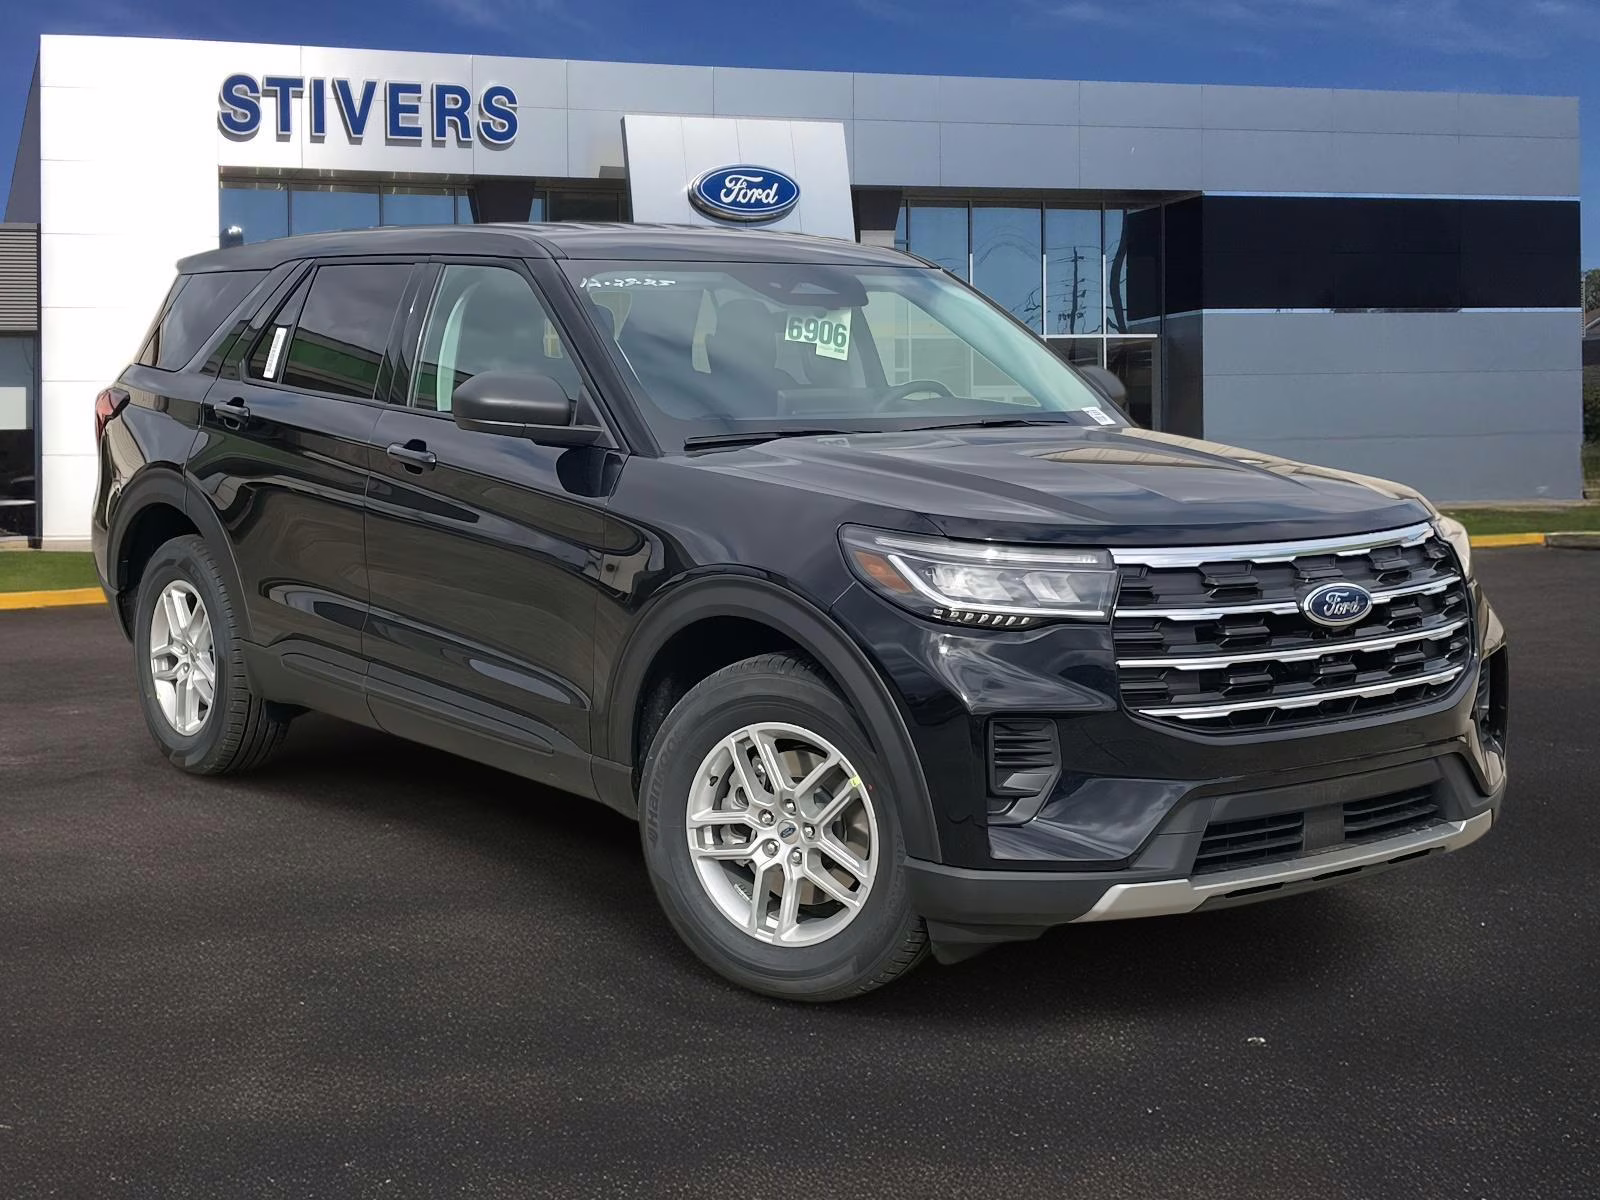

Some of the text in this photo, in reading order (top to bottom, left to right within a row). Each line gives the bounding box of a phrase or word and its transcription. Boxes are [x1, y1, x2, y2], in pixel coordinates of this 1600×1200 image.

[219, 73, 519, 144] STIVERS
[720, 174, 779, 204] Ford
[787, 317, 847, 348] 6906
[1323, 591, 1360, 617] Ford
